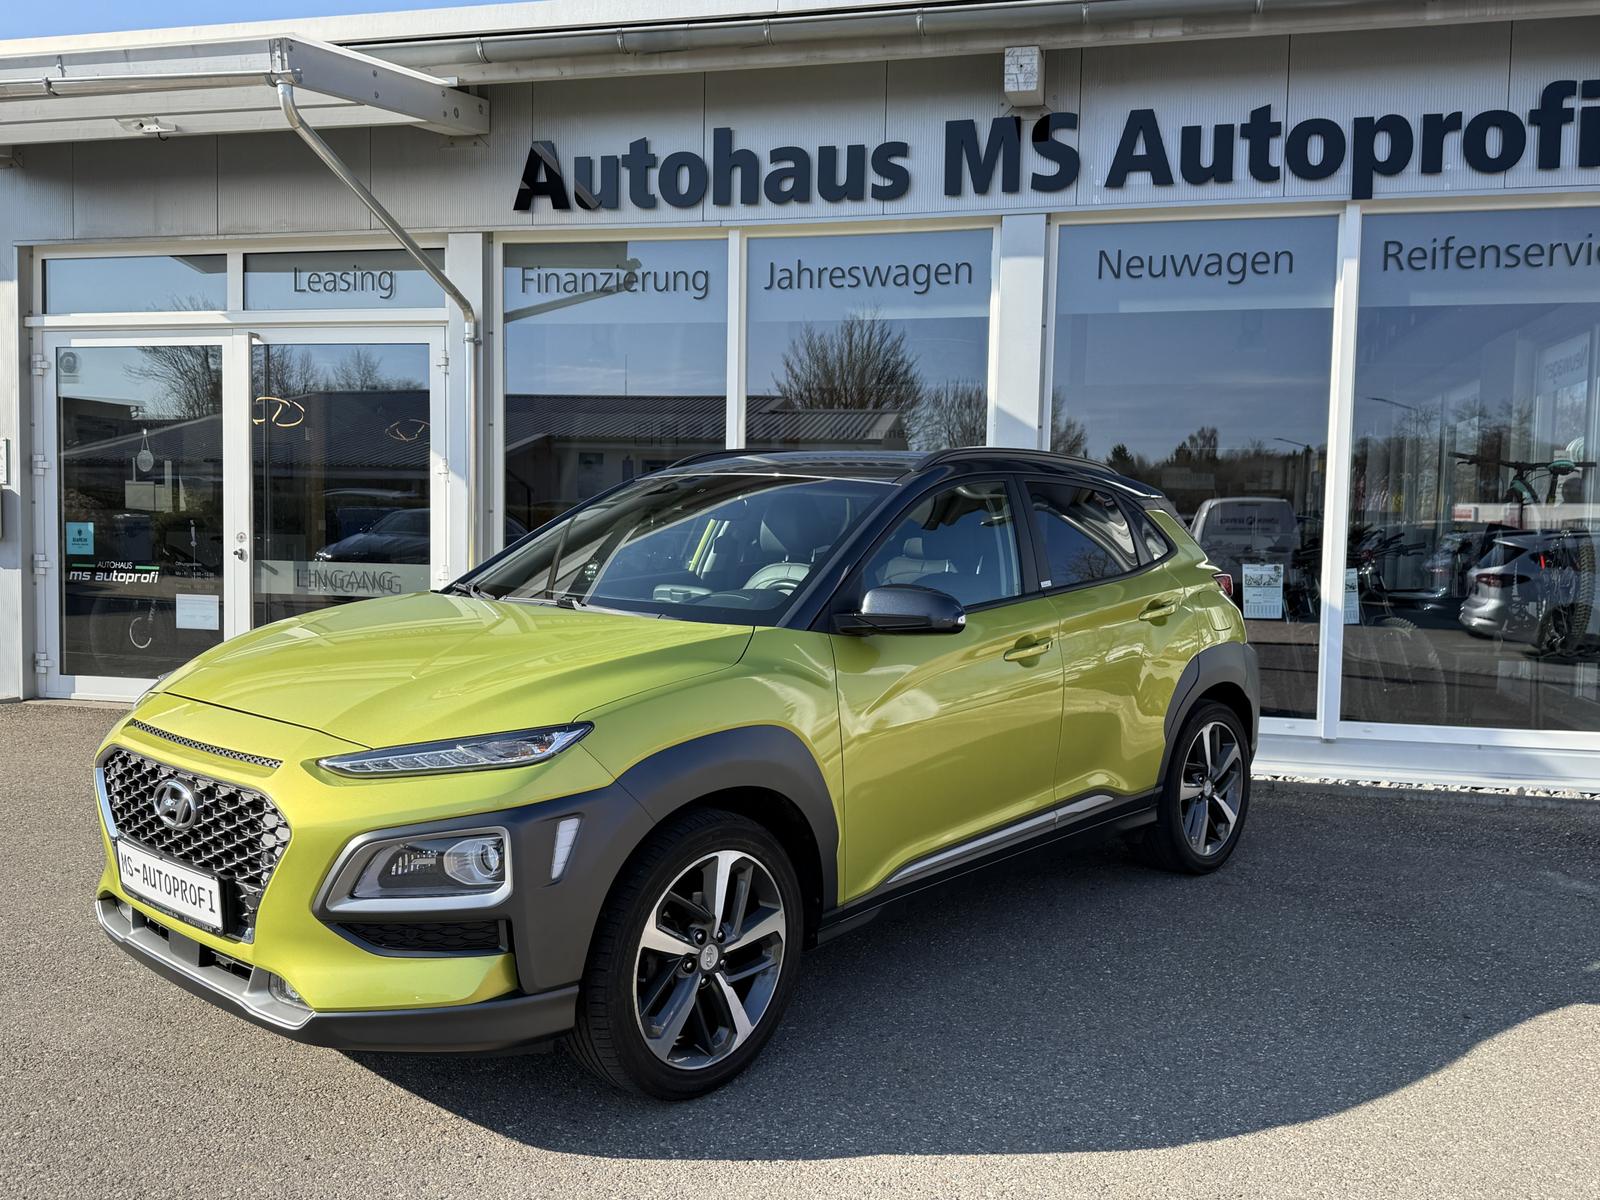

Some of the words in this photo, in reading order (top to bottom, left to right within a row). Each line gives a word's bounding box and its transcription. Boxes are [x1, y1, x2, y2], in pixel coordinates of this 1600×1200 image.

[513, 127, 910, 211] Autohaus
[944, 112, 1080, 196] MS
[1103, 79, 1600, 200] Autoprofi
[1097, 248, 1294, 284] Neuwagen
[1383, 233, 1600, 272] Reifenservi
[293, 265, 394, 300] Leasing
[521, 265, 709, 300] Finanzierung
[764, 258, 973, 294] Jahreswagen
[69, 571, 91, 580] ms
[95, 570, 159, 584] autoprofi
[97, 561, 133, 569] AUTOHAUS
[120, 852, 216, 914] MS-AUTOPROFI
